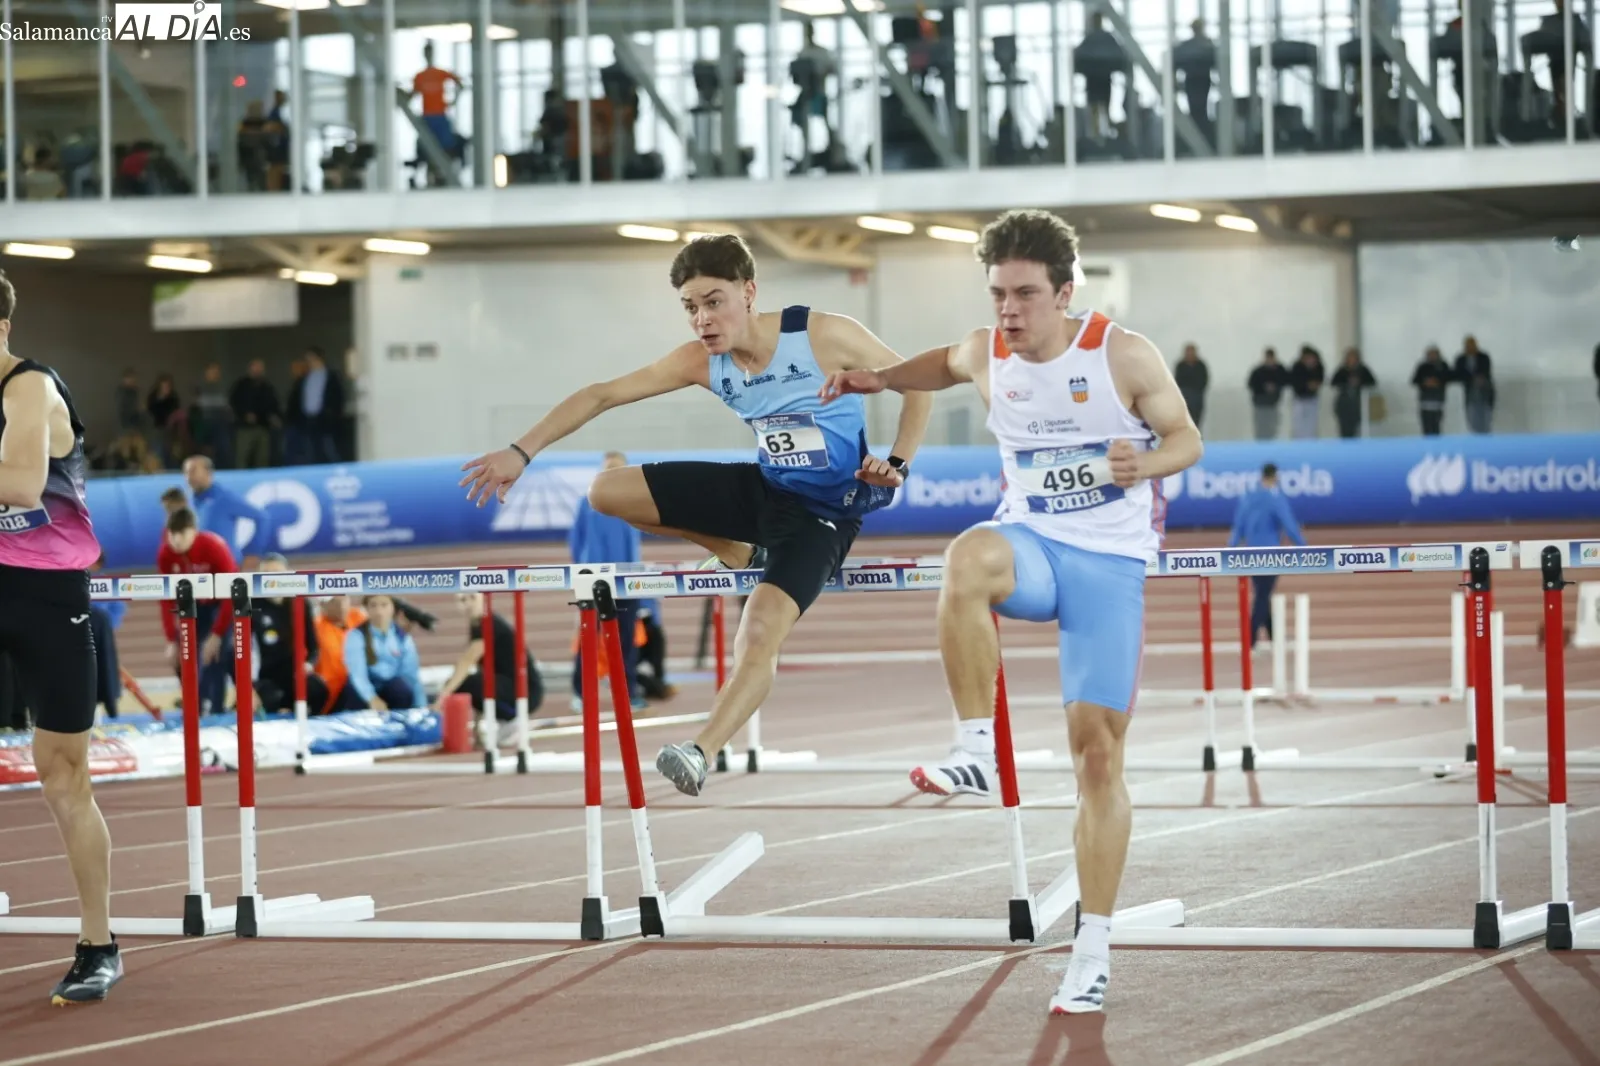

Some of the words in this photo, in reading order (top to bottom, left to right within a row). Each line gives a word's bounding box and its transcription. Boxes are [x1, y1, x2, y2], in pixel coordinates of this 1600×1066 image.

[765, 432, 795, 454] 63
[1043, 463, 1095, 492] 496
[1227, 553, 1299, 568] SALAMANCA
[1301, 553, 1327, 567] 2025
[1416, 552, 1453, 562] Iberdrola
[368, 574, 429, 589] SALAMANCA
[431, 574, 454, 587] 2025
